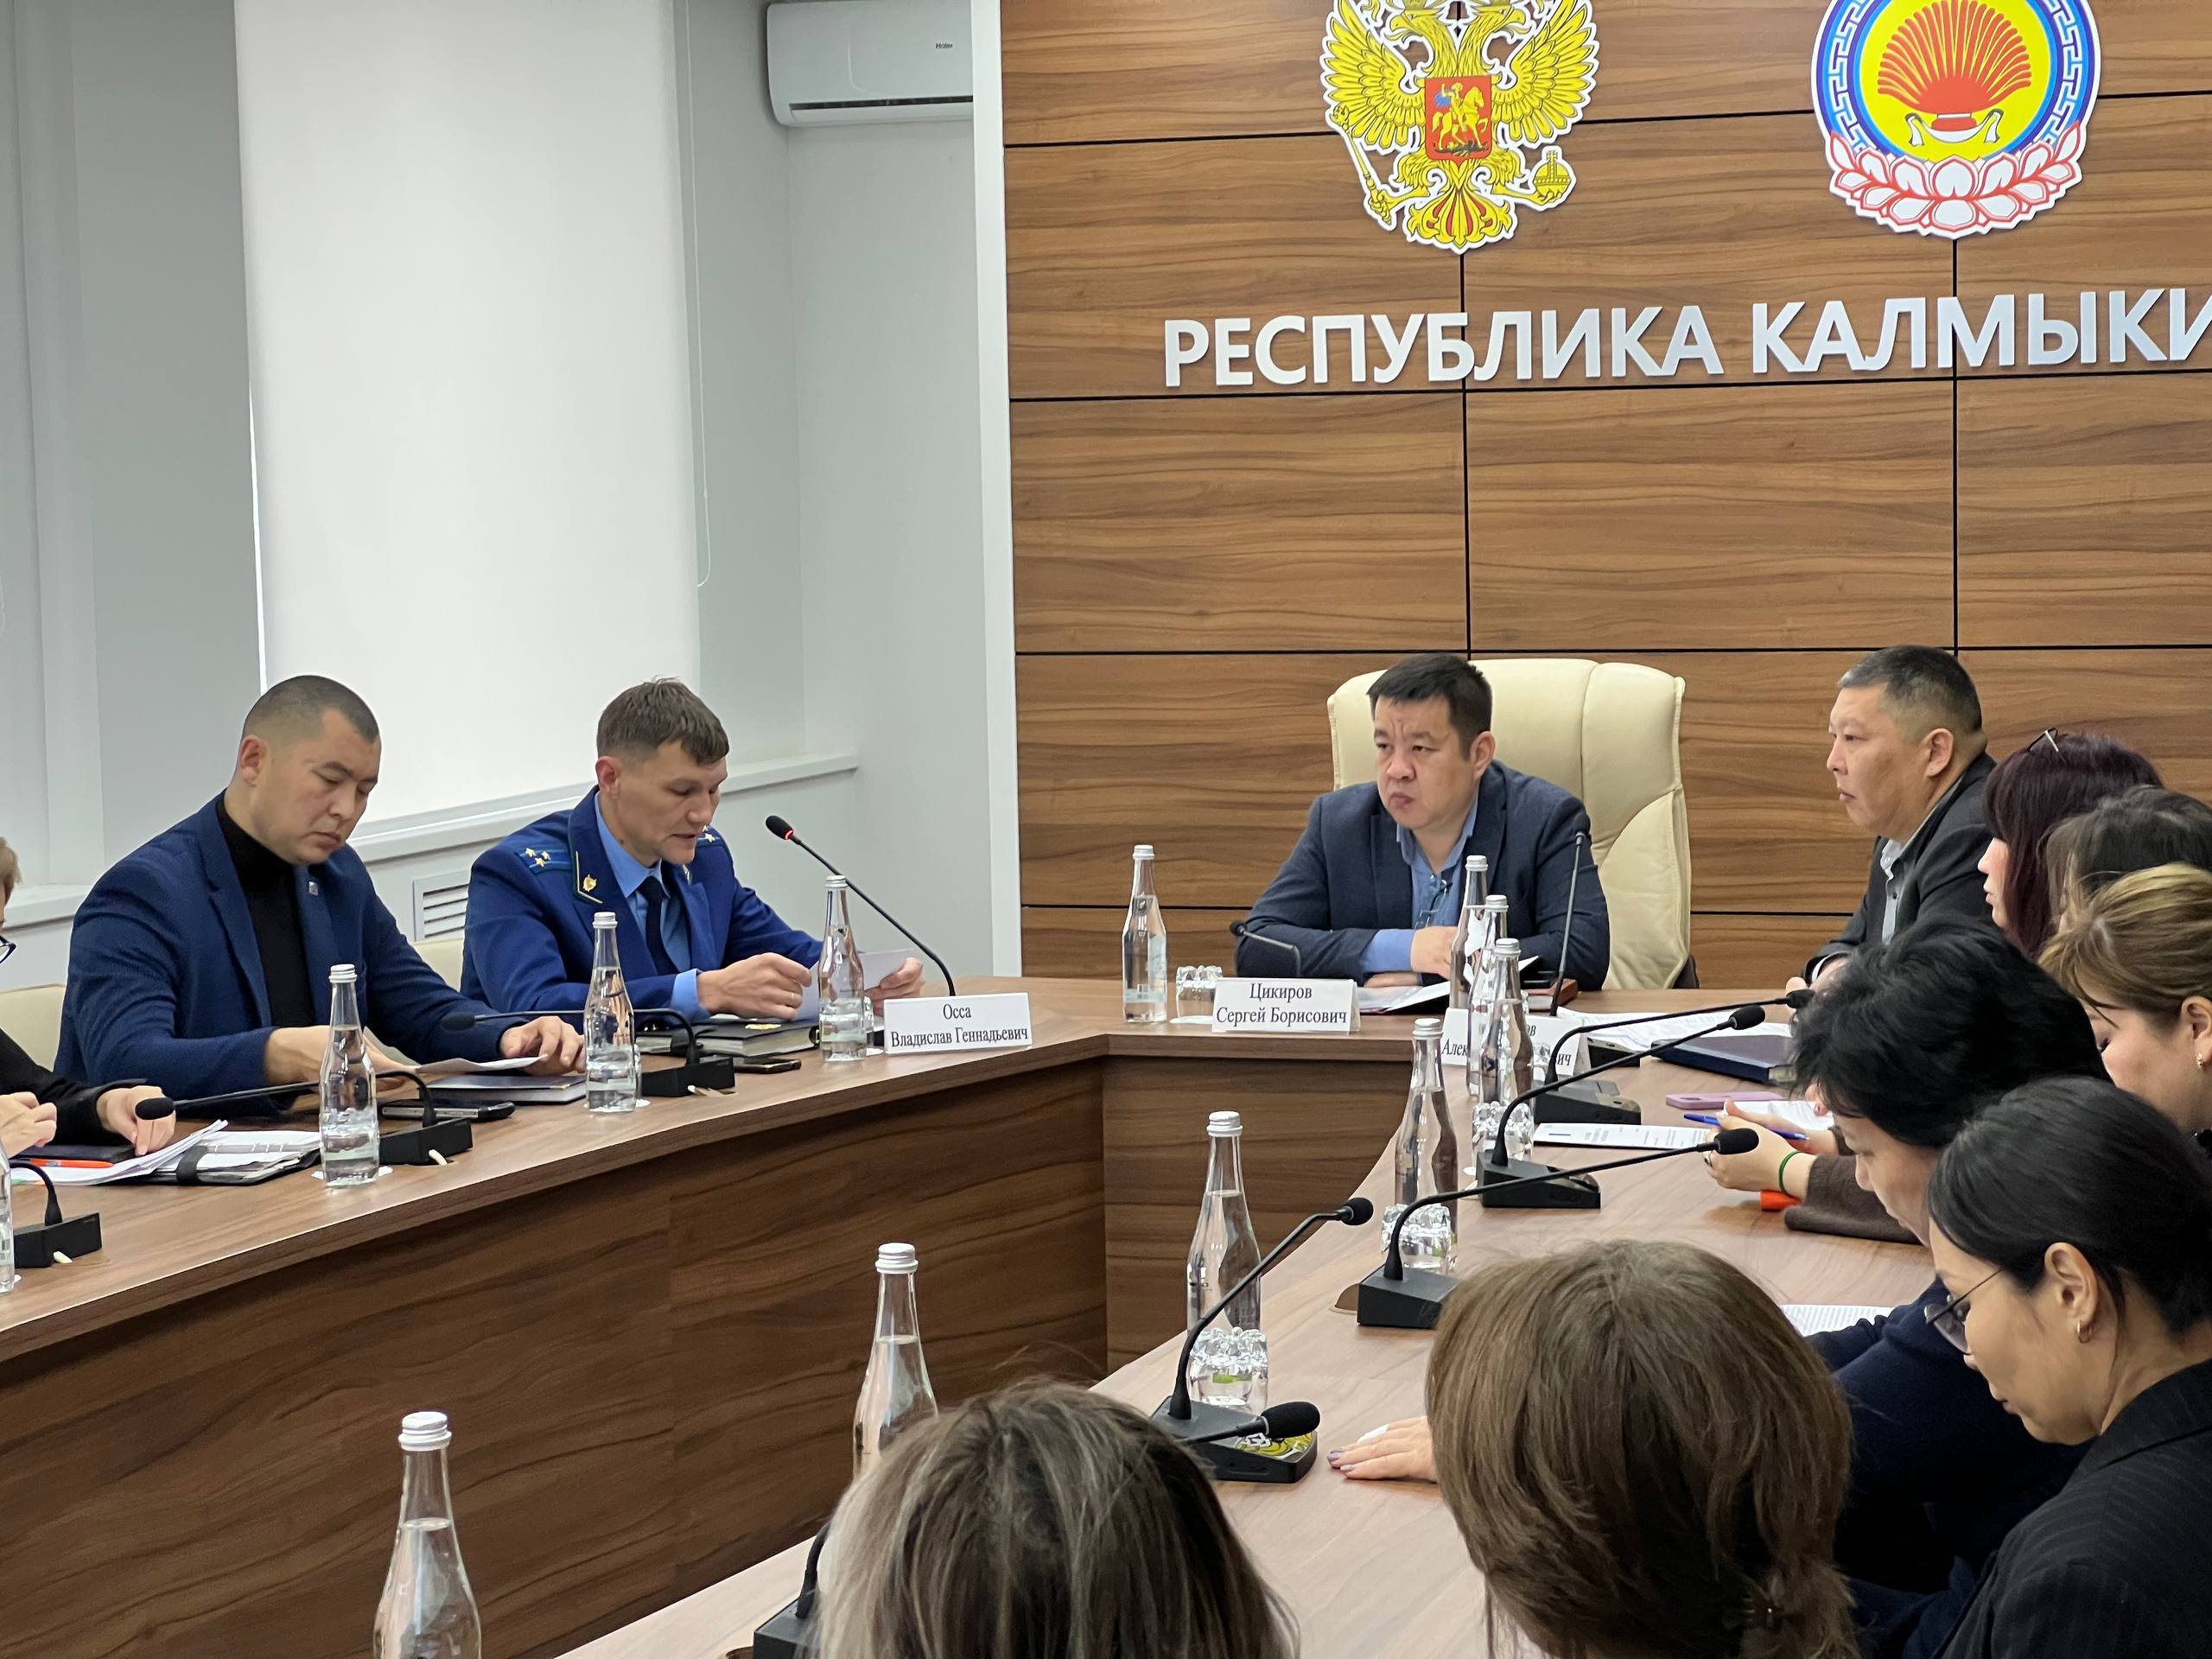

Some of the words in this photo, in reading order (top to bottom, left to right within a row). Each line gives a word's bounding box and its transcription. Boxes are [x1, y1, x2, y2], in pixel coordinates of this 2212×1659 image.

[1164, 305, 1724, 387] РЕСПУБЛИКА
[1249, 982, 1313, 1002] Цикиров
[943, 1003, 972, 1020] Осса
[1216, 1007, 1266, 1027] Сергей
[1270, 1007, 1347, 1027] Борисович
[891, 1030, 952, 1048] Владислав
[955, 1027, 1029, 1044] Геннадьевич
